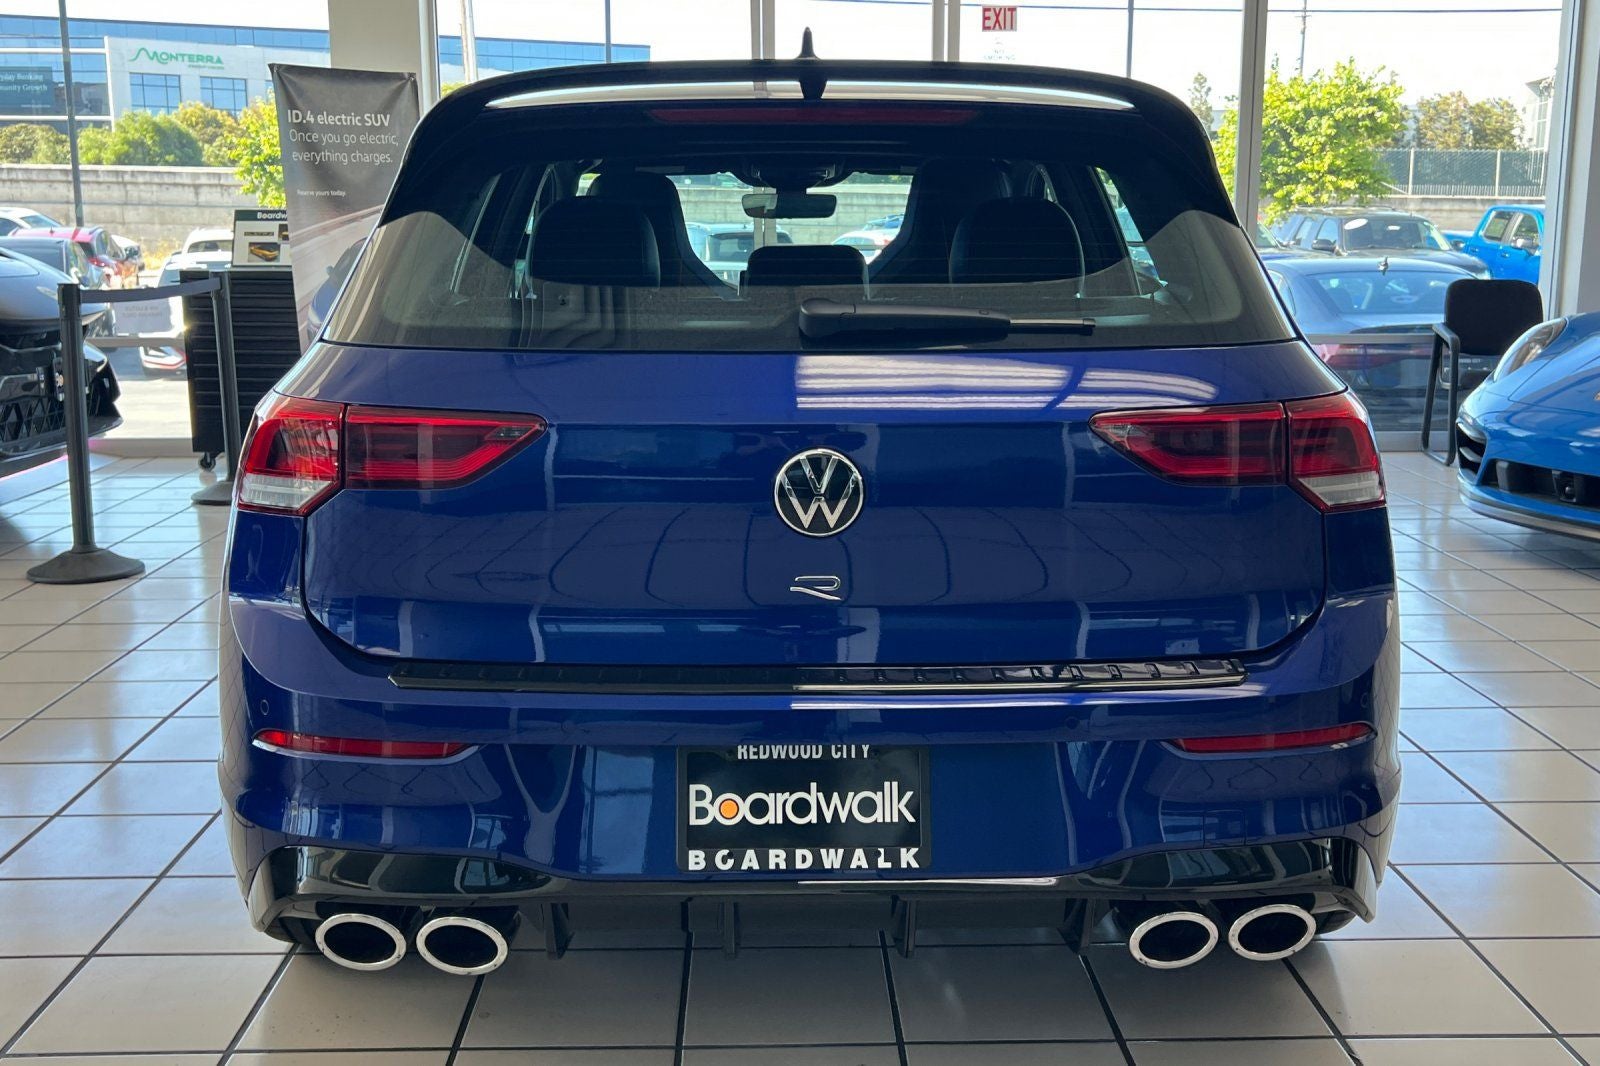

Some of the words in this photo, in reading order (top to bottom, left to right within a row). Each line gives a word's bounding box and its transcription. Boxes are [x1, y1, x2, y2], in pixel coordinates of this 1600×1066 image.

[982, 7, 1017, 30] EXIT
[129, 47, 224, 65] MONTERRA
[287, 109, 315, 124] ID.4
[317, 111, 362, 126] electric
[364, 113, 391, 127] SUV
[289, 128, 319, 142] Once
[320, 133, 341, 146] you
[343, 134, 357, 147] go
[359, 132, 399, 147] electric,
[292, 149, 348, 165] everything
[350, 150, 393, 166] charges.
[737, 744, 823, 760] REDWOOD
[689, 781, 917, 826] Boardwalk
[687, 847, 920, 871] BOARDWALK
